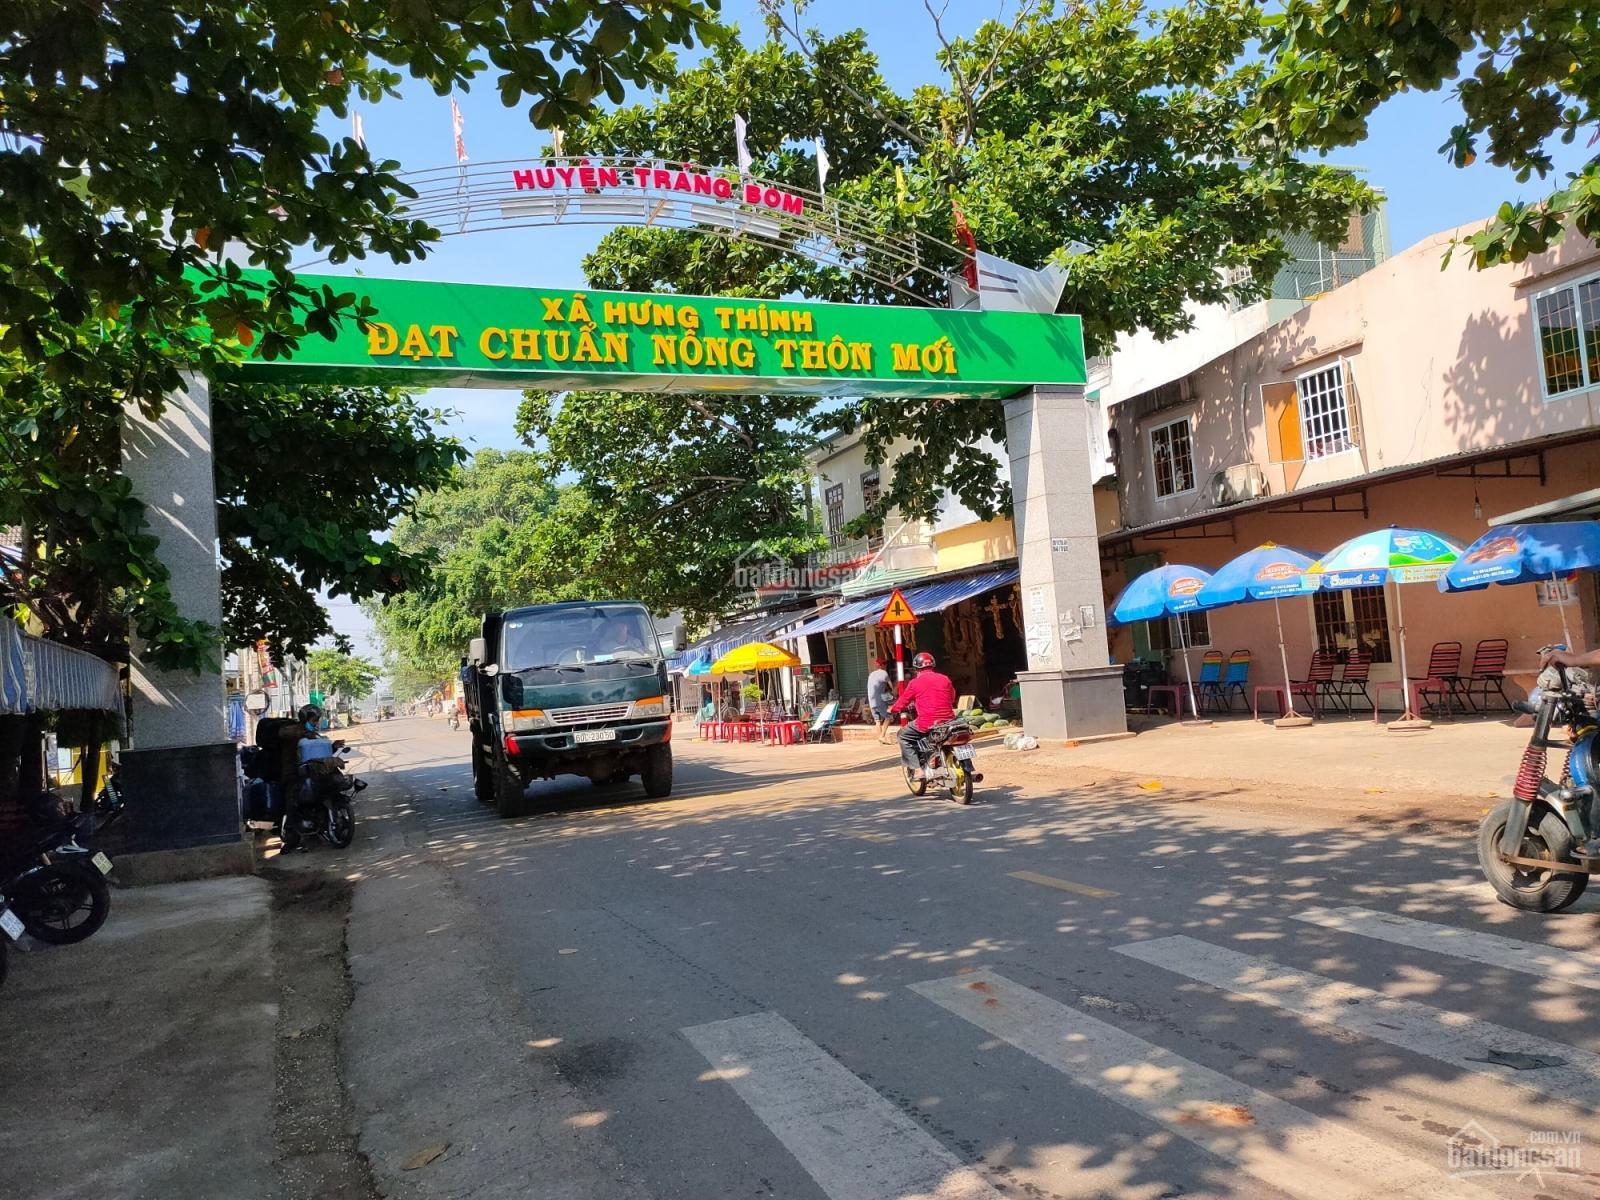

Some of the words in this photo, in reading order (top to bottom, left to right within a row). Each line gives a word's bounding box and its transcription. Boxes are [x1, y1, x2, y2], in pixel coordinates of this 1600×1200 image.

[512, 158, 620, 195] HUYỆN
[633, 163, 732, 199] TRẢNG
[743, 183, 804, 216] BOM
[540, 293, 592, 323] XÃ
[604, 299, 700, 330] HƯNG
[715, 303, 813, 337] THỊNH
[367, 322, 459, 361] ĐẠT
[479, 321, 629, 363] CHUẨN
[651, 328, 756, 368] NÔNG
[774, 334, 873, 371] THÔN
[890, 335, 958, 374] MỚI
